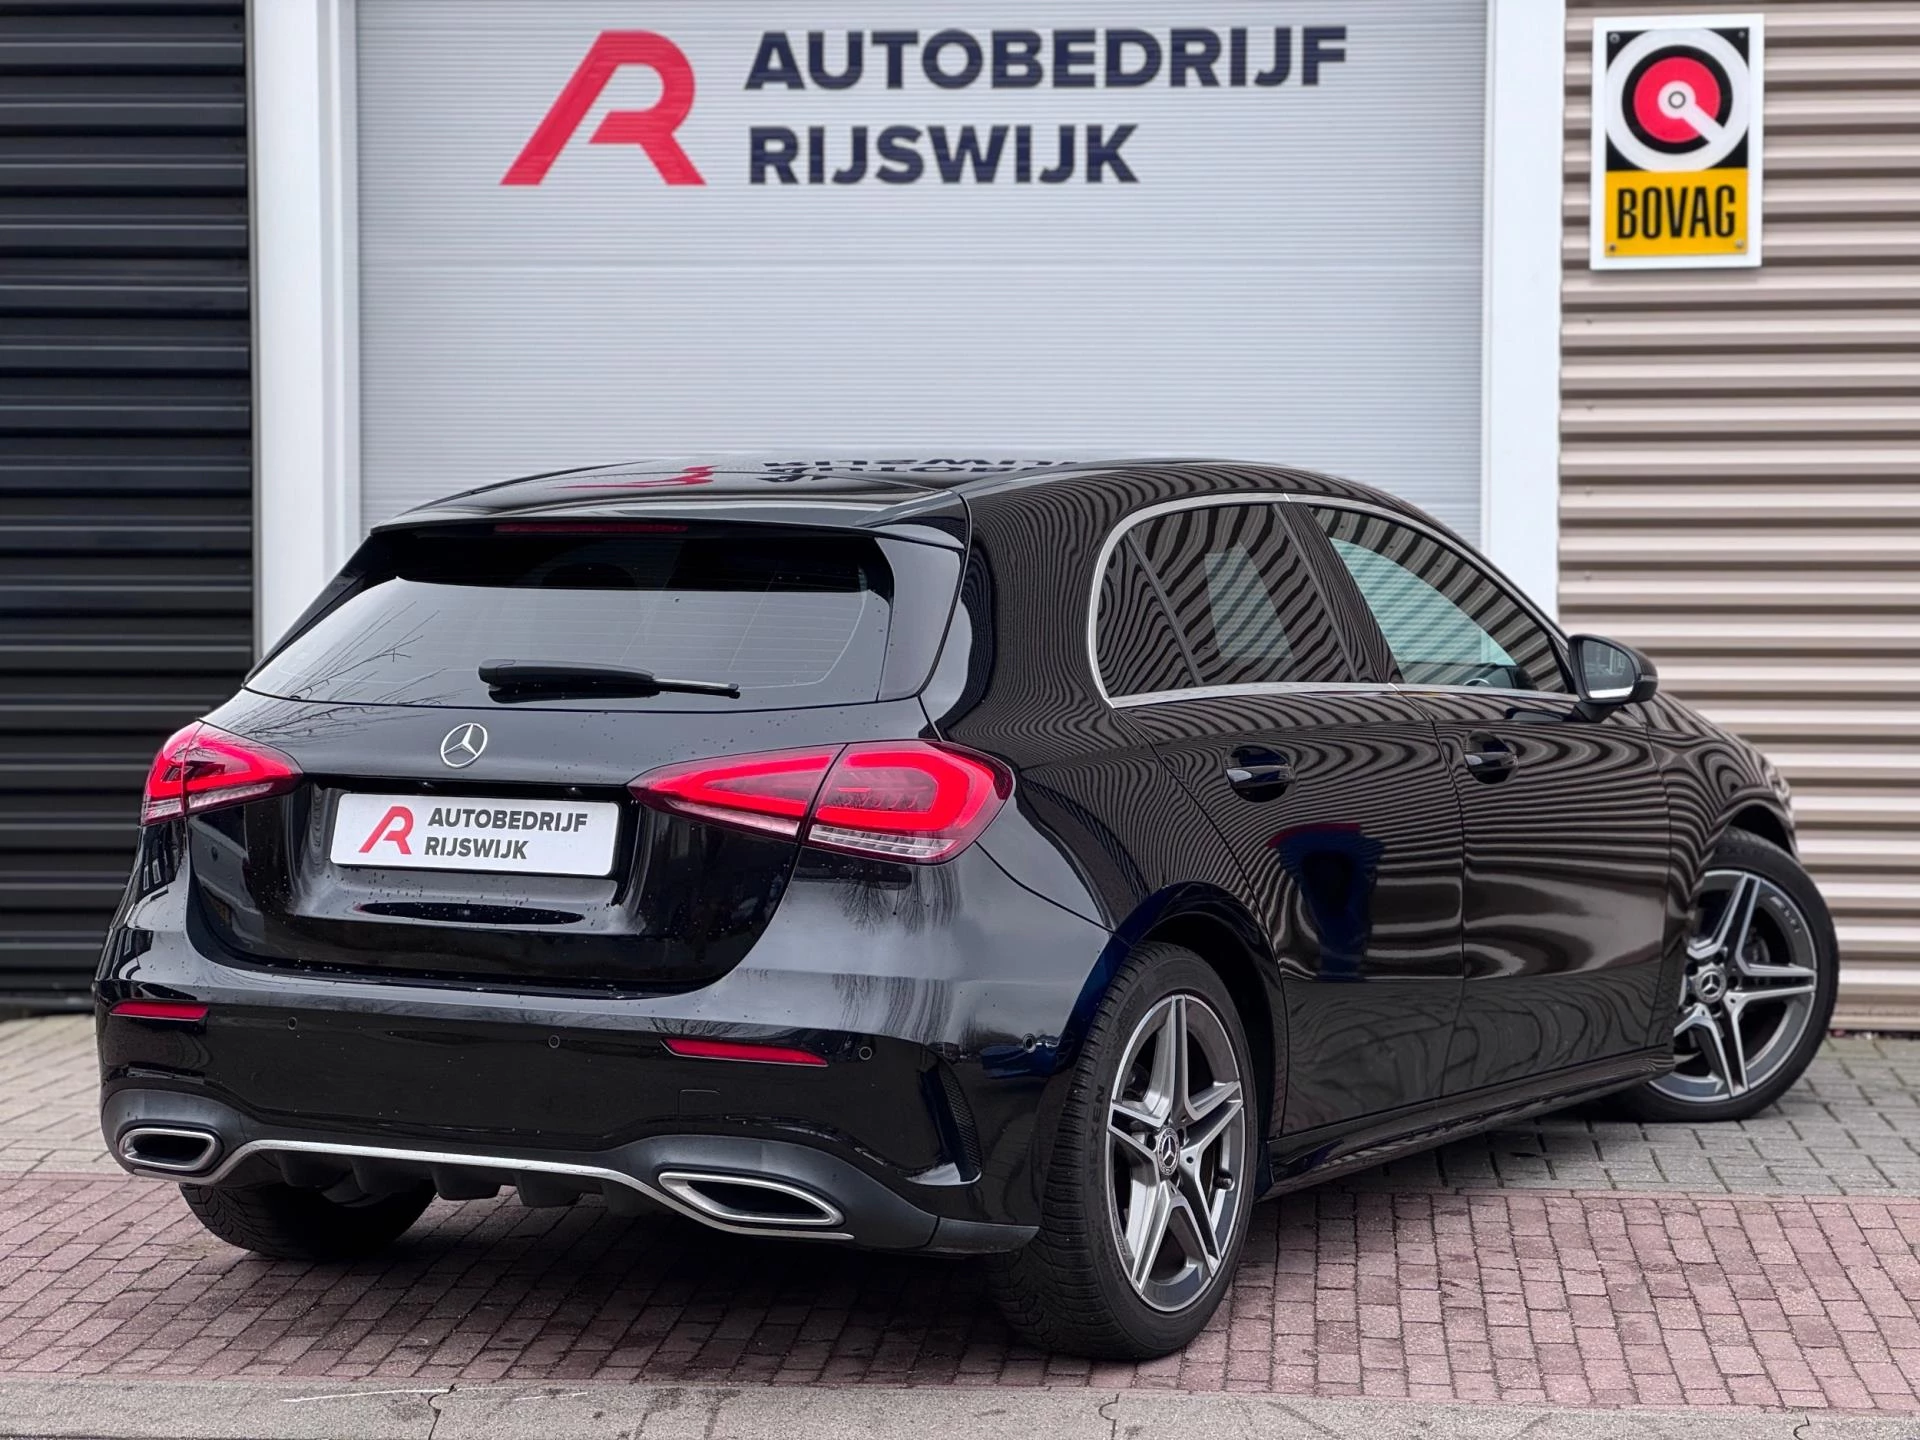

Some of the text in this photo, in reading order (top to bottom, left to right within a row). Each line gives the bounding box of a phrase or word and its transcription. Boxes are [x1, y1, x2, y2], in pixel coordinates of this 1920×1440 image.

[745, 26, 1348, 91] AUTOBEDRIJF
[749, 124, 1140, 186] RIJSWIJK
[1616, 185, 1736, 240] BOVAG
[424, 836, 529, 860] RIJSWIJK
[427, 807, 588, 833] AUTOBEDRIJF
[1088, 1083, 1106, 1186] NEXEN
